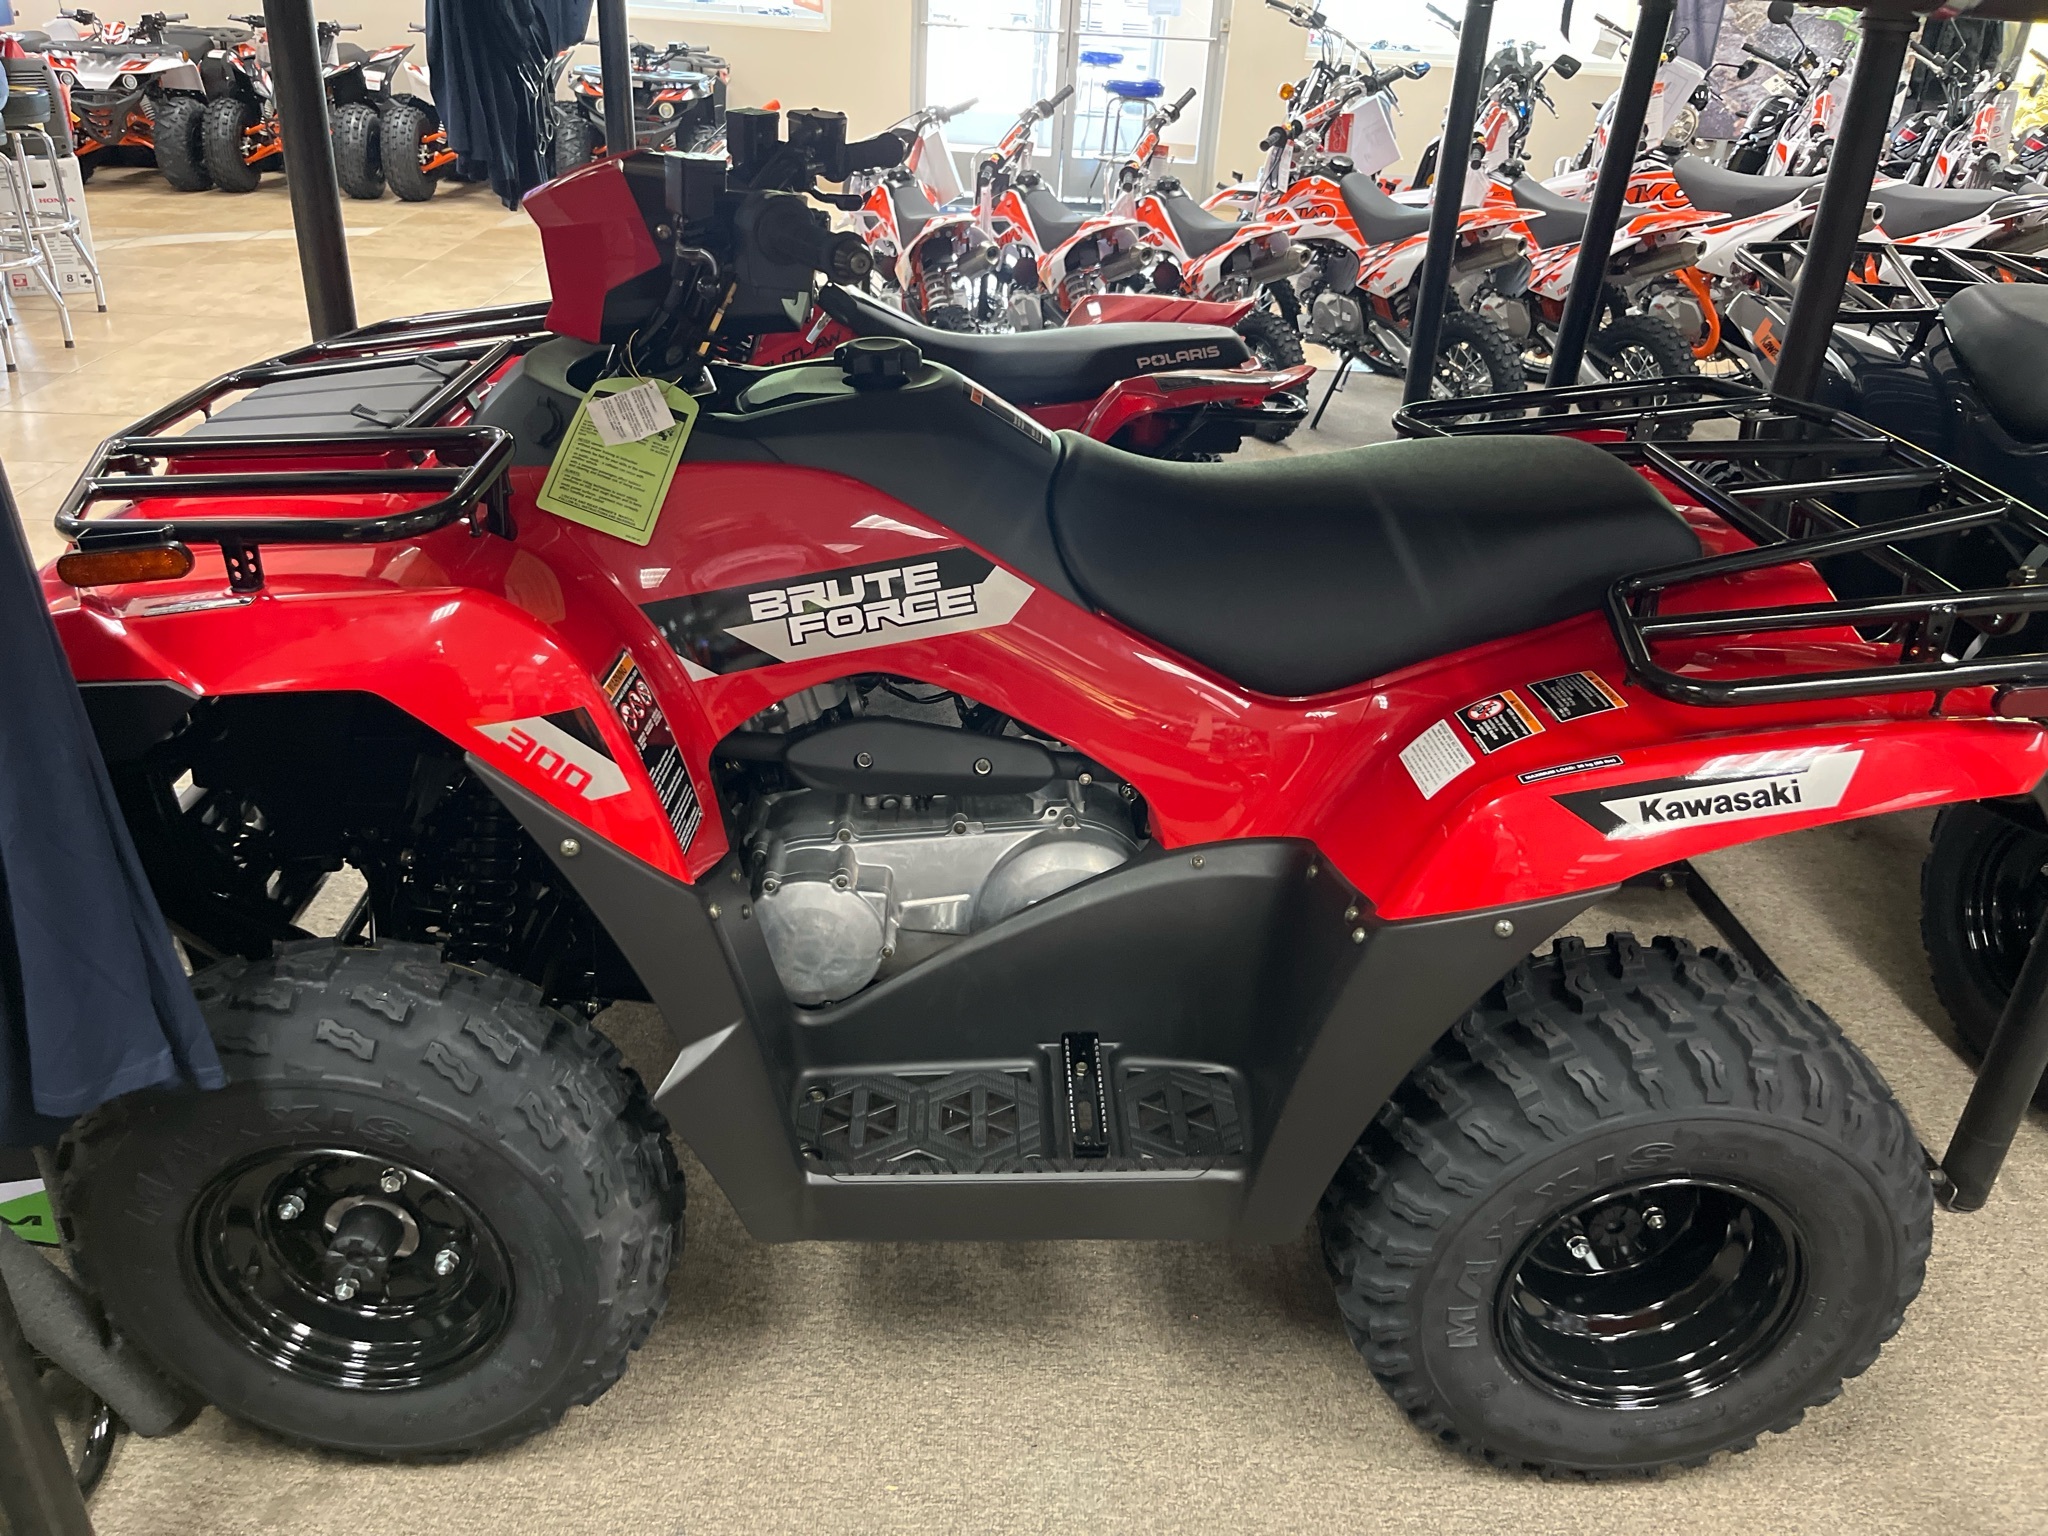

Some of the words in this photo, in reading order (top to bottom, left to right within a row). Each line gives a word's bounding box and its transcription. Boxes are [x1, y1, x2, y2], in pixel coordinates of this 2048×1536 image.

[66, 274, 74, 282] 8
[1136, 345, 1220, 369] POLARIS
[1760, 335, 1780, 358] Kawa
[748, 561, 941, 621] BRUTE
[789, 584, 979, 647] FORCE
[1596, 678, 1622, 703] WARNING
[498, 727, 594, 792] 300
[1639, 779, 1803, 824] Kawasaki
[1448, 1140, 1678, 1349] MAXXIS
